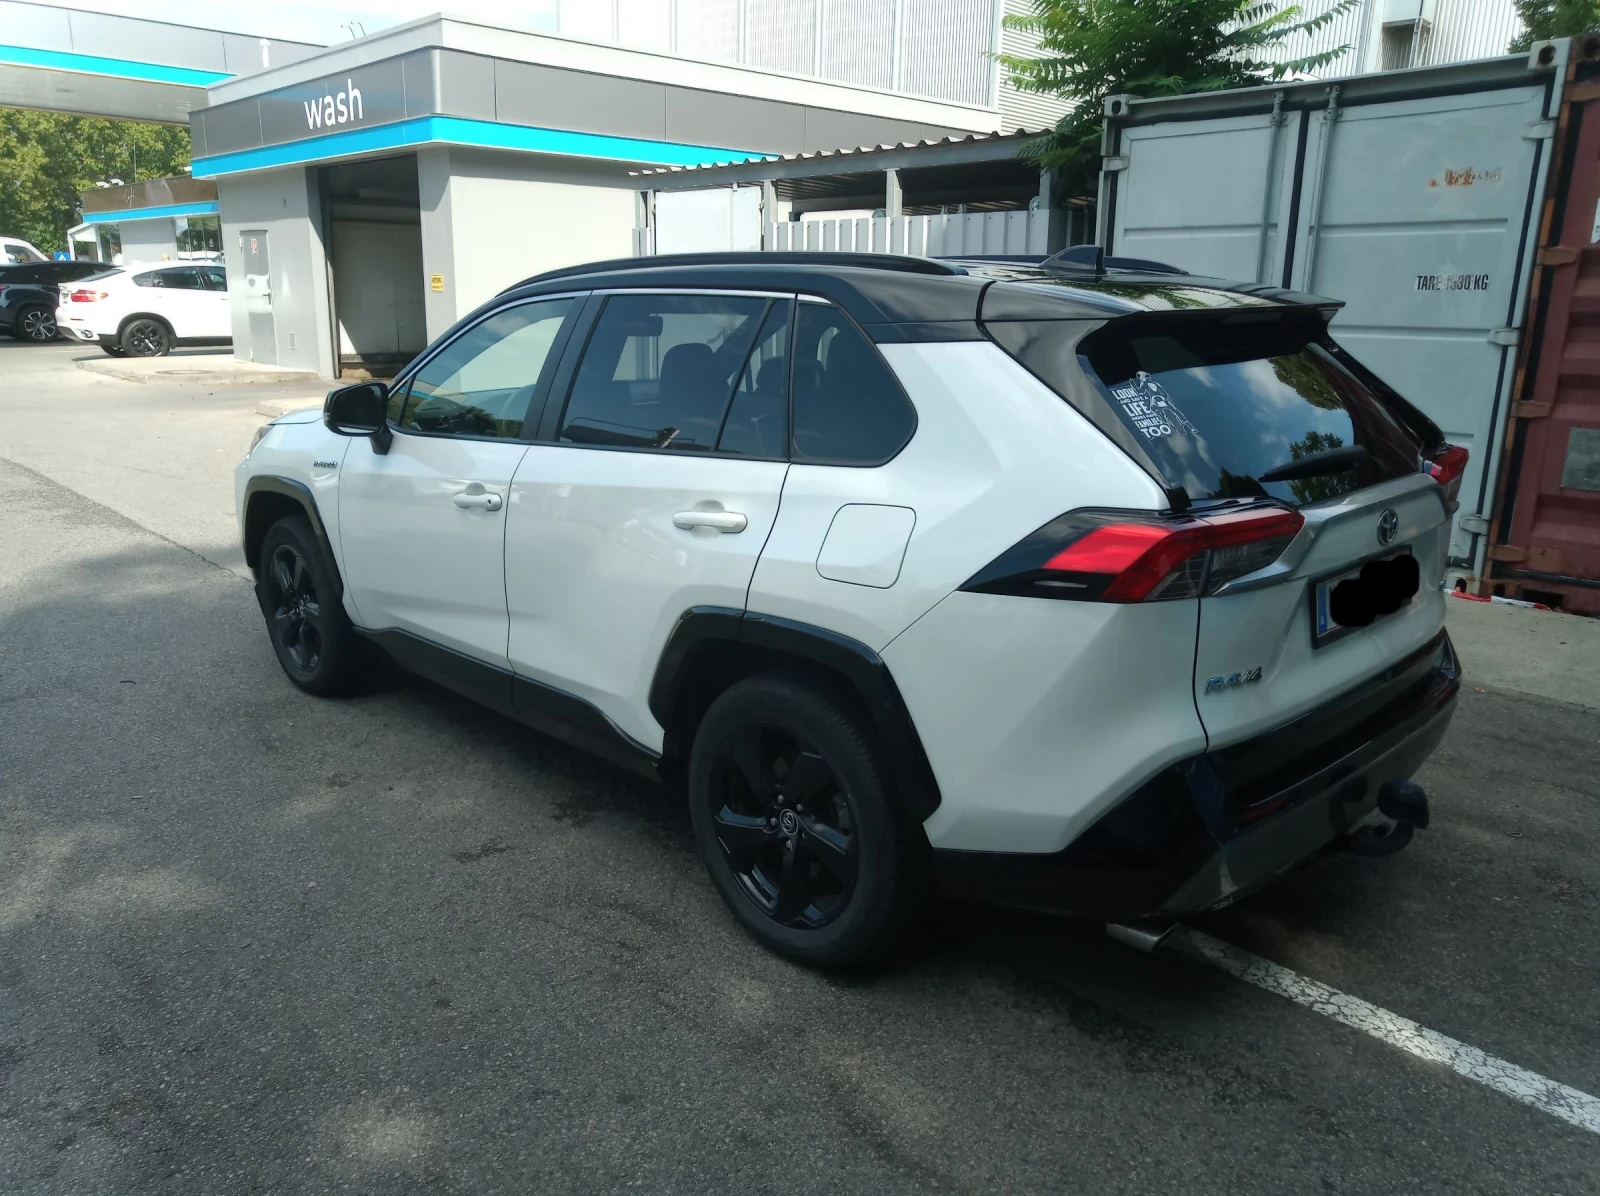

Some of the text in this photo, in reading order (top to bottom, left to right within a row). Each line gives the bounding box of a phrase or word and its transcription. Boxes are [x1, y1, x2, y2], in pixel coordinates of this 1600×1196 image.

[304, 78, 363, 130] wash
[1416, 274, 1441, 291] TARE
[1473, 273, 1489, 291] KG
[1111, 387, 1139, 400] LOOK
[1122, 401, 1151, 417] LIFE
[1134, 416, 1163, 429] FAMILIES
[1140, 424, 1172, 439] TOO
